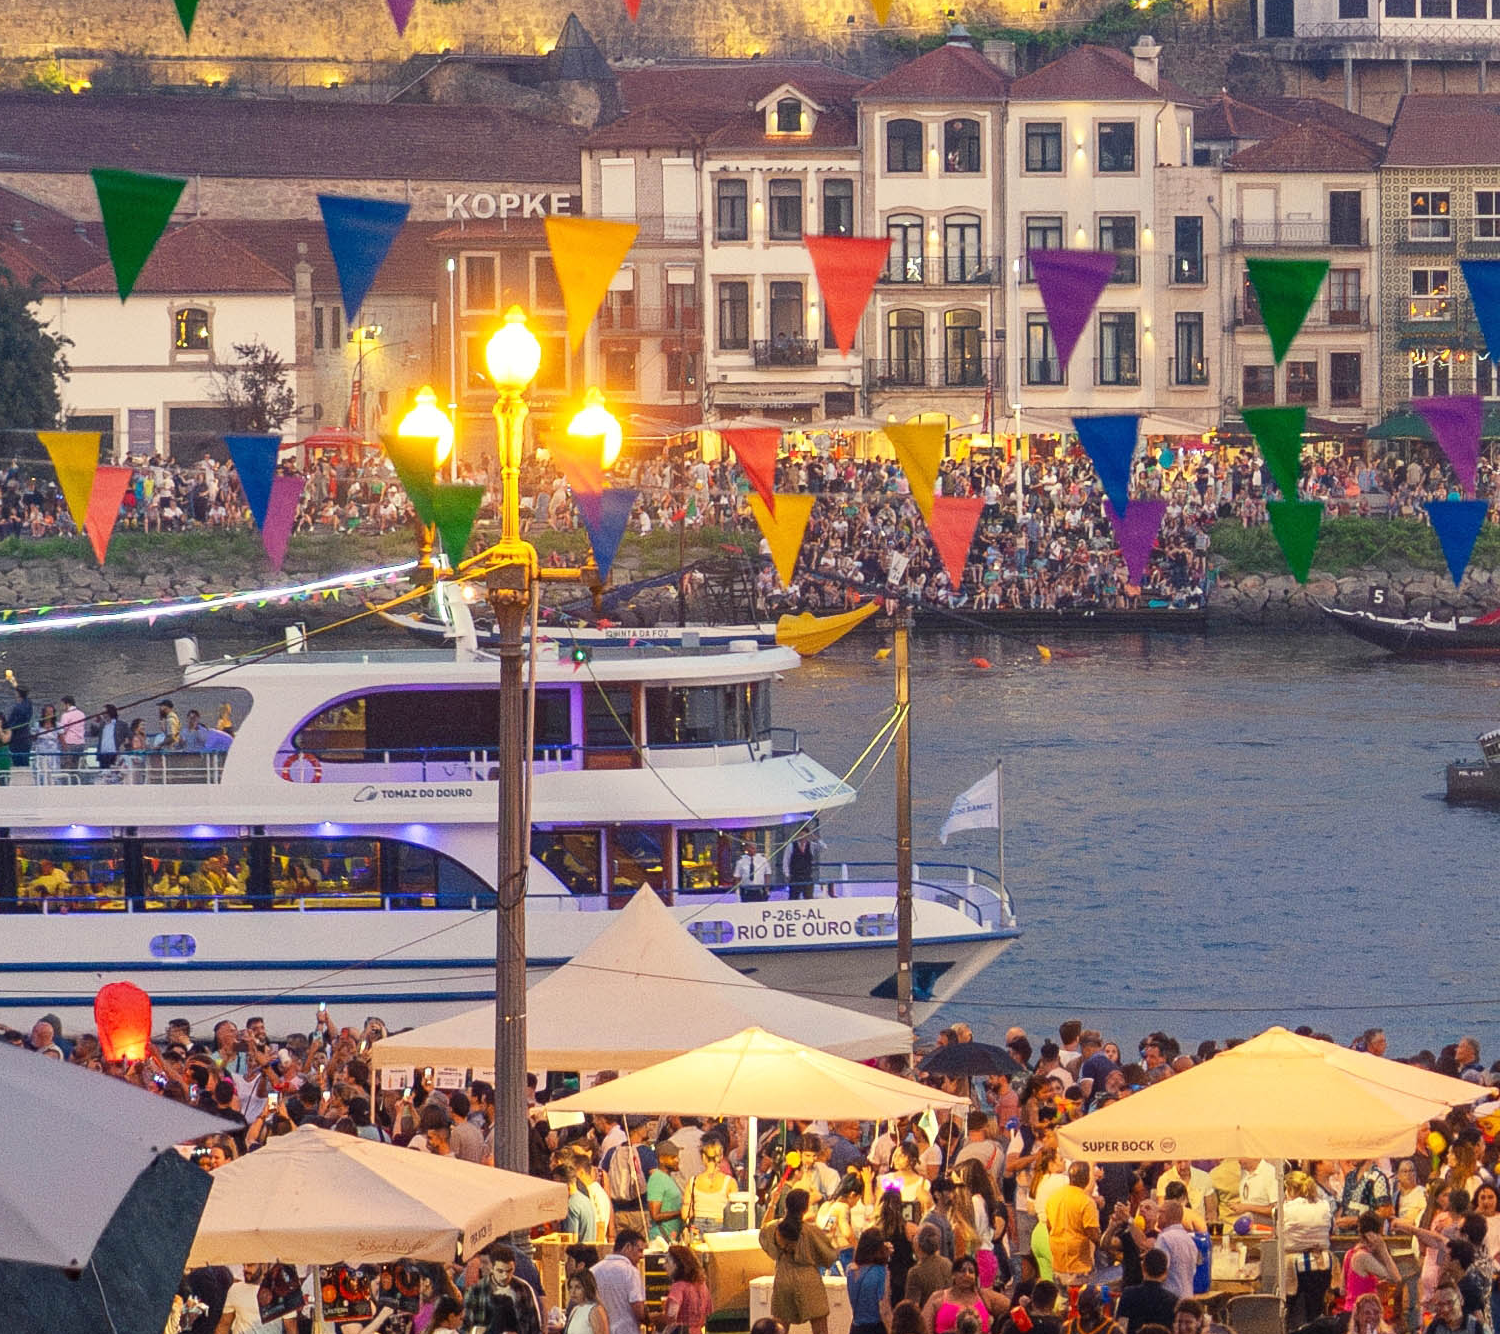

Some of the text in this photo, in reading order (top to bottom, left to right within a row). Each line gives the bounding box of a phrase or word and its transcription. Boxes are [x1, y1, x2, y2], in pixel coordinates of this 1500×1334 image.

[446, 192, 572, 221] KOPKE
[1373, 589, 1384, 604] 5
[605, 629, 669, 638] QUINTA DA FOZ
[381, 788, 473, 799] TOMAZ DO DOURO
[761, 908, 825, 923] P-265-AL
[737, 920, 852, 941] RIO DE OURO
[1081, 1140, 1155, 1153] SUPER BOCK
